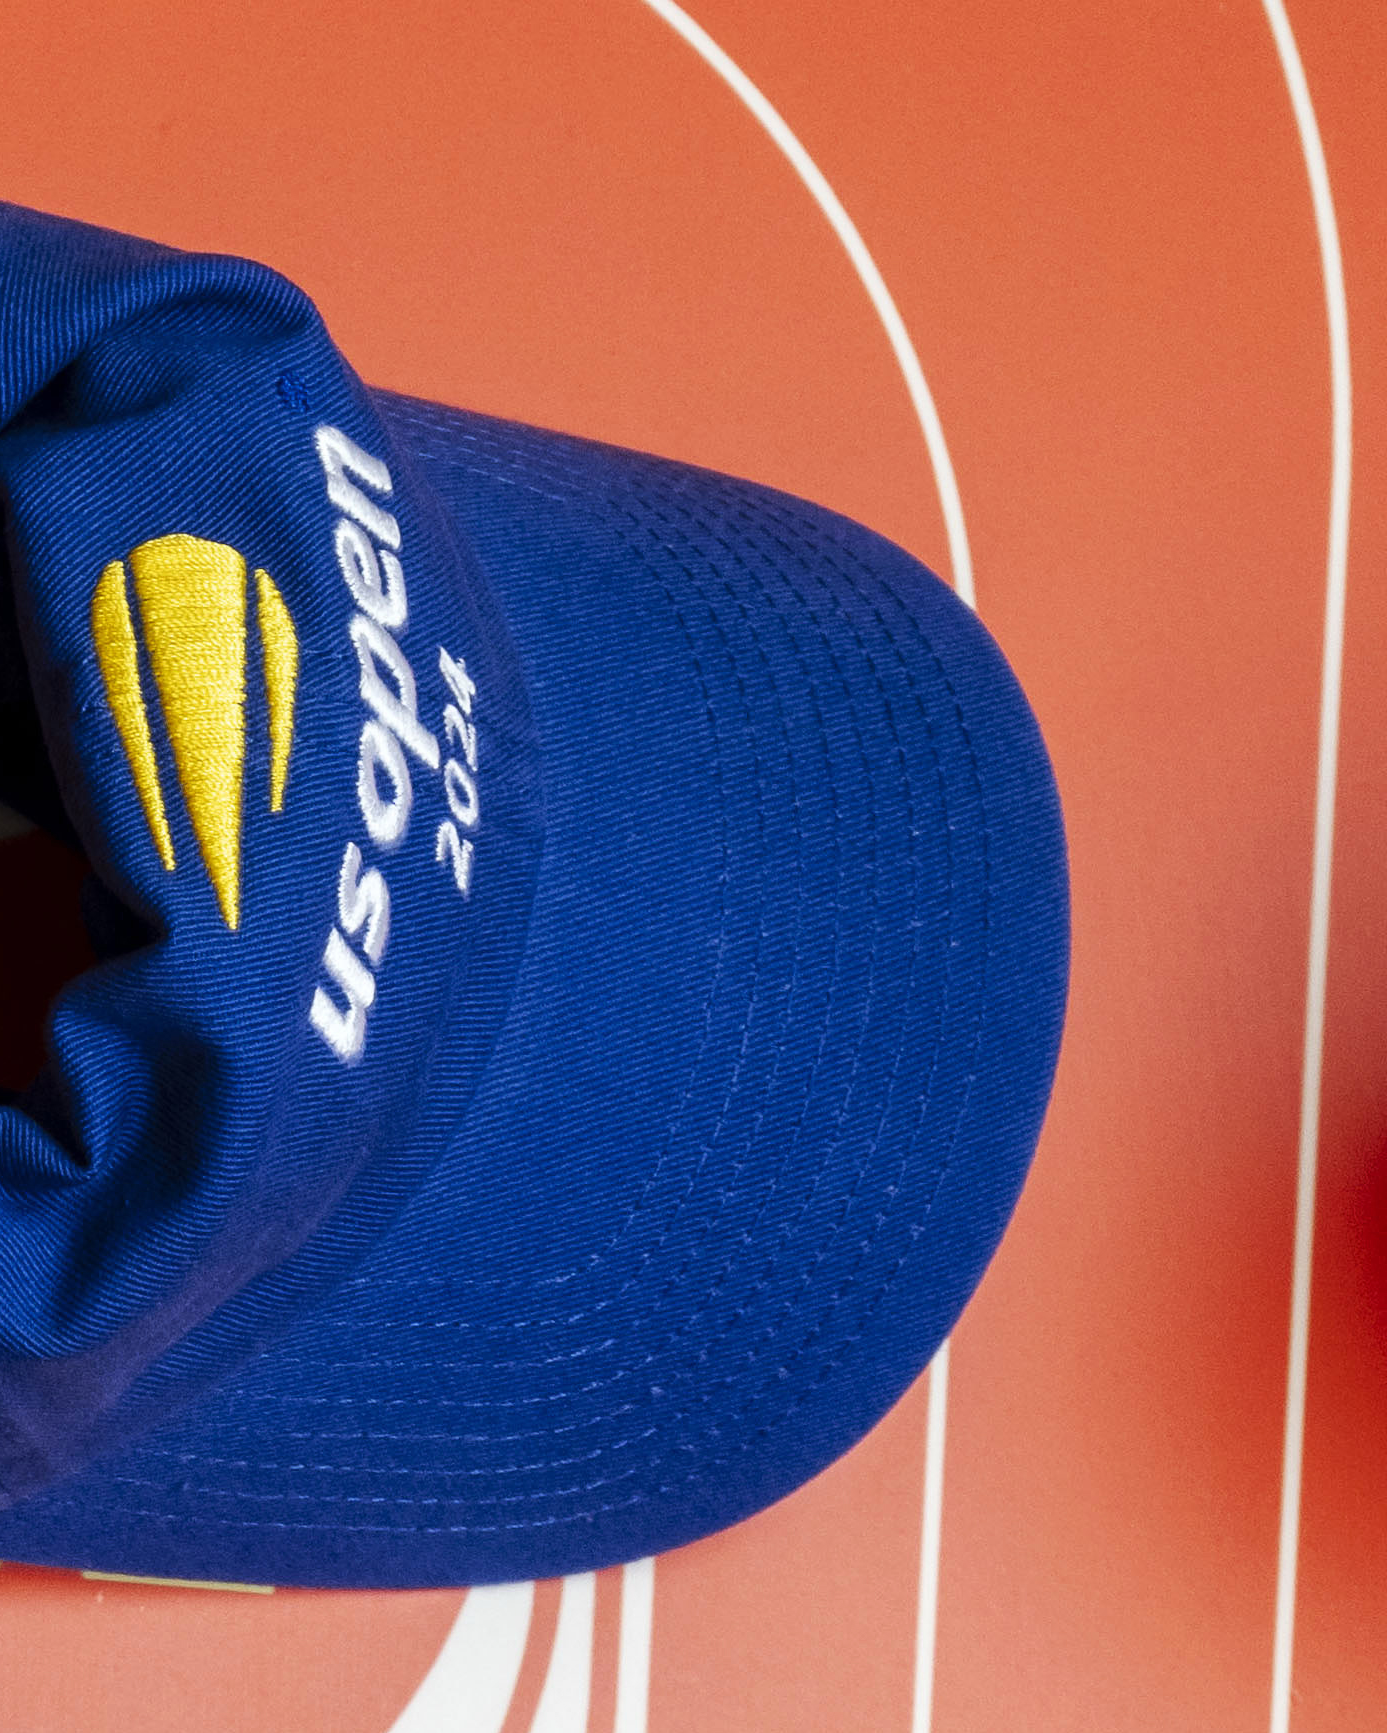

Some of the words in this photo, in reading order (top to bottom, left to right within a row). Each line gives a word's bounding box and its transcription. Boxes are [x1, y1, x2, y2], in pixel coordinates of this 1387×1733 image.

[315, 425, 440, 846] open
[436, 646, 477, 895] 2024
[310, 842, 390, 1064] us
